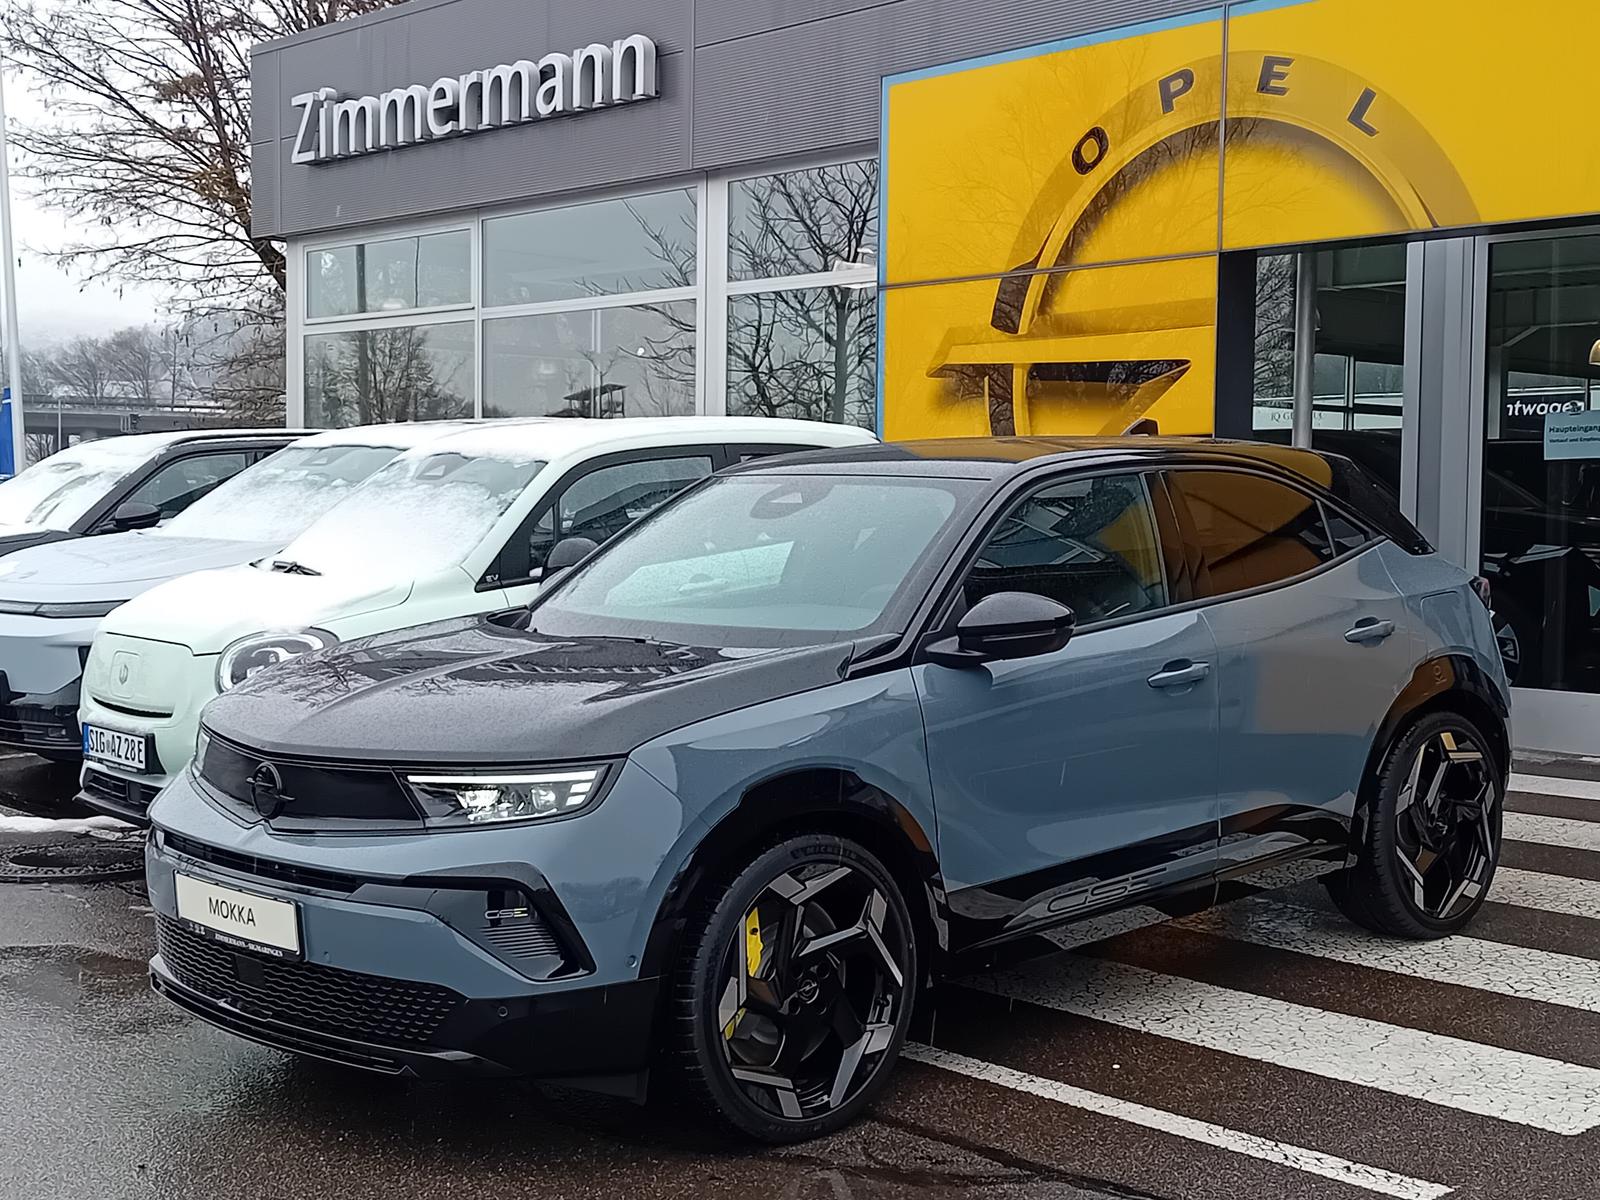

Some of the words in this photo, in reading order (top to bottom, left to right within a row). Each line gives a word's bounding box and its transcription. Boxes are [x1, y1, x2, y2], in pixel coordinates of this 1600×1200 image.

[290, 33, 660, 166] Zimmermann
[1071, 54, 1380, 176] OPEL
[89, 729, 105, 754] SIG
[110, 734, 123, 759] AZ
[208, 896, 256, 927] MOKKA
[484, 907, 529, 919] GSE
